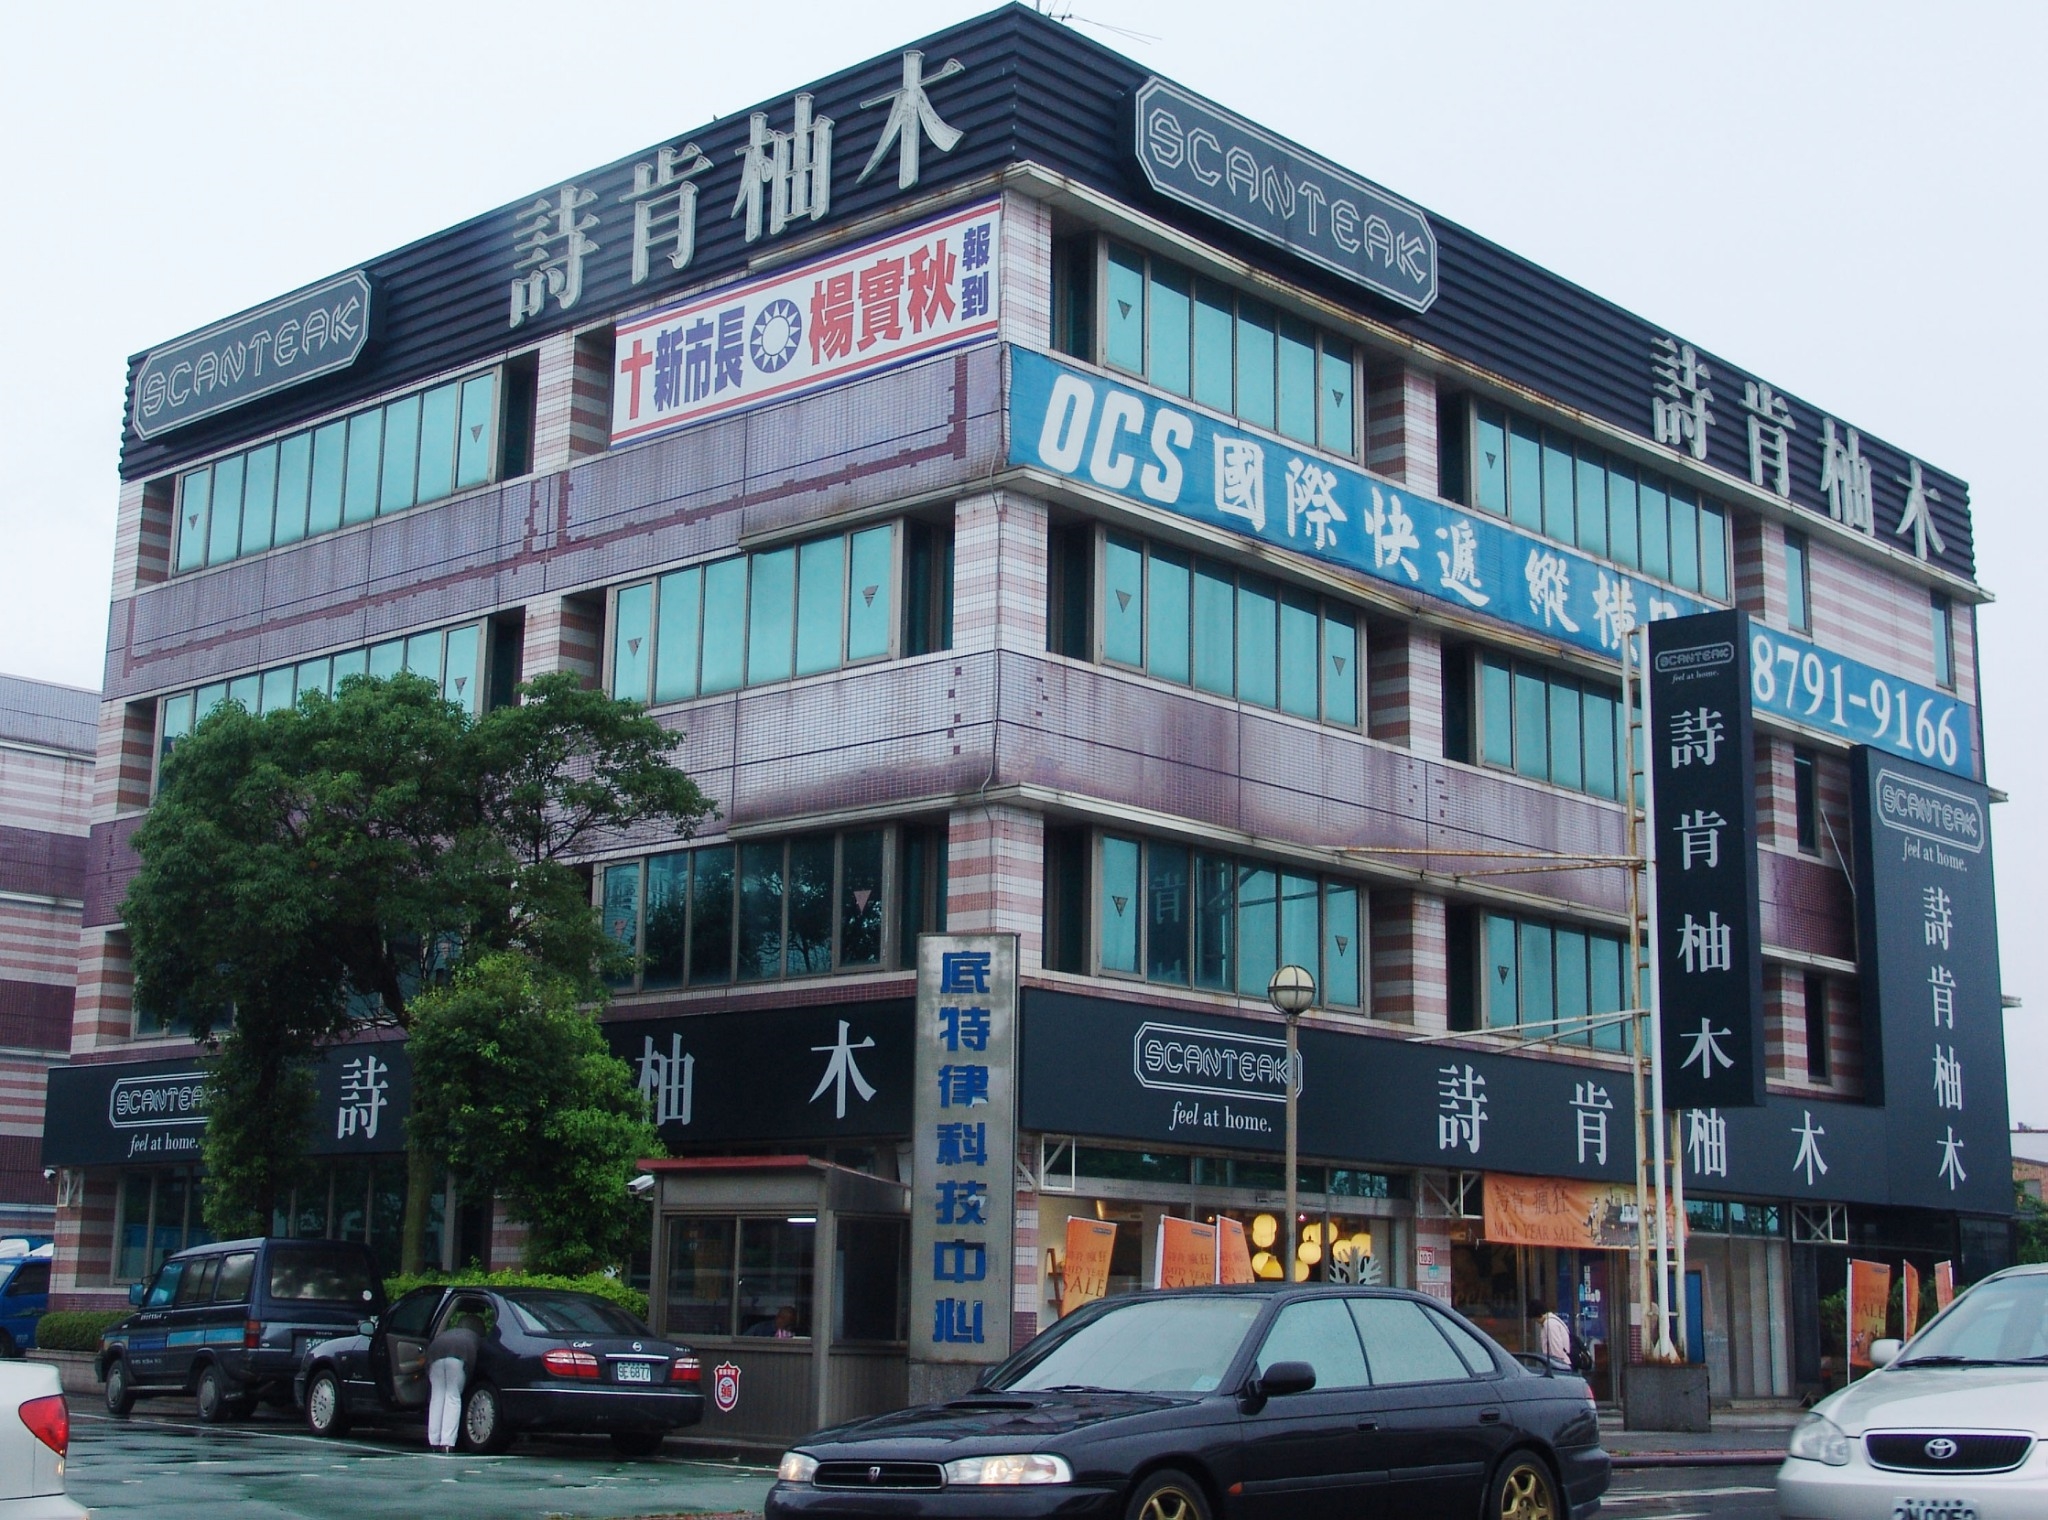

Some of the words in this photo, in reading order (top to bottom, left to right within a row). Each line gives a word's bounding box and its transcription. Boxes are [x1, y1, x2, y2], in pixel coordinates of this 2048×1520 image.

[509, 49, 965, 328] 詩肯柚木
[1146, 107, 1428, 286] SCANTEAK
[808, 238, 957, 365] 楊實秋
[961, 222, 991, 321] 報到
[140, 297, 363, 418] SCANTEAK
[1650, 335, 1946, 562] 詩肯柚木
[1038, 374, 1195, 503] OCS
[1752, 635, 1958, 766] 8791-9166
[1660, 647, 1729, 667] SCANTEAK
[1672, 673, 1684, 684] feel
[1882, 784, 1977, 838] SCANTEAK
[1902, 836, 1920, 862] feel
[1923, 847, 1934, 862] at
[1936, 844, 1967, 872] home.
[1670, 706, 1734, 1079] 詩肯柚木
[1145, 1039, 1288, 1084] SCANTEAK
[1922, 885, 1967, 1191] 詩肯柚木
[127, 1133, 149, 1158] feel
[150, 1136, 162, 1151] at
[165, 1132, 199, 1150] home.
[932, 950, 991, 1344] 底特律科技中心
[1168, 1101, 1199, 1131] feel
[1203, 1108, 1219, 1127] at
[1225, 1106, 1272, 1132] home.
[1437, 1064, 1829, 1186] 詩肯柚木
